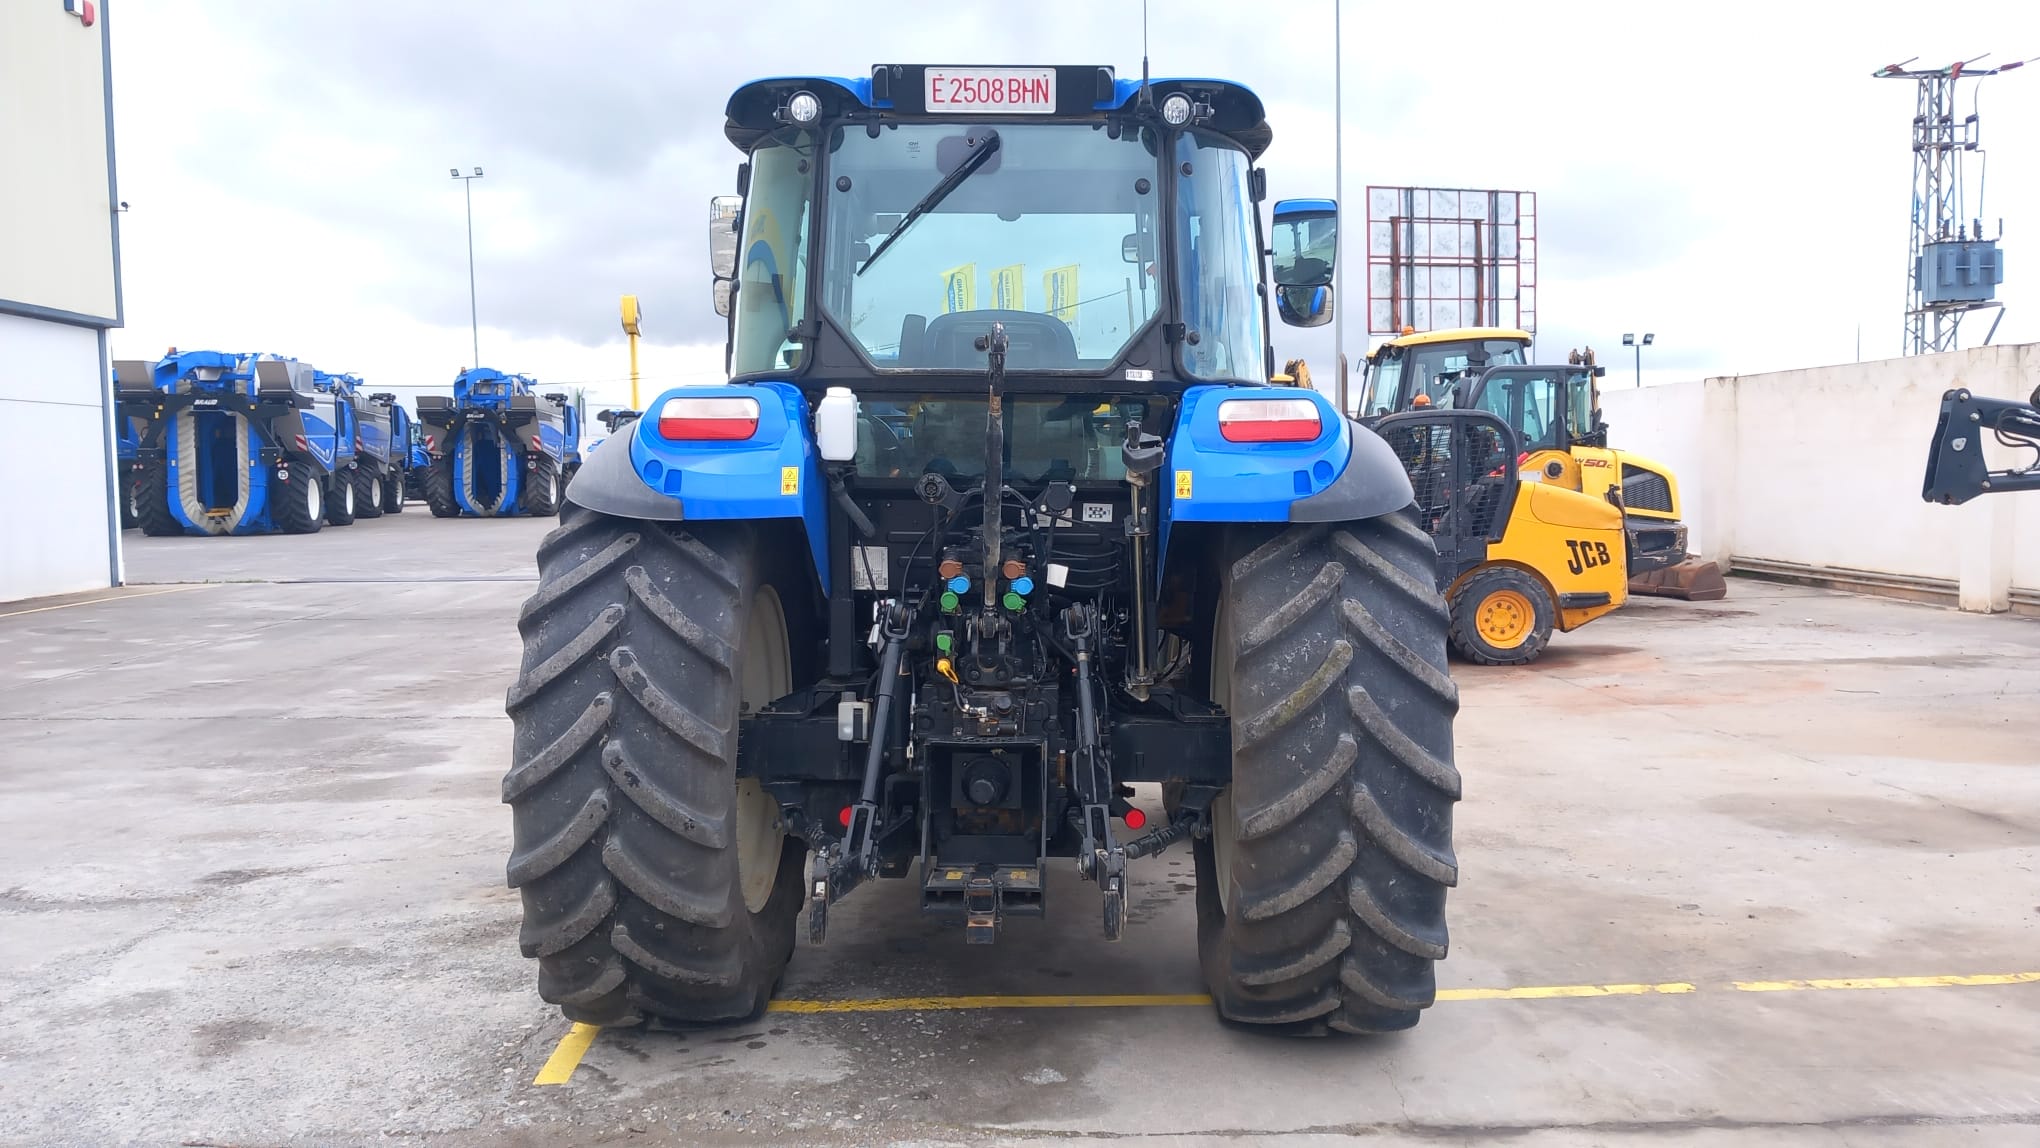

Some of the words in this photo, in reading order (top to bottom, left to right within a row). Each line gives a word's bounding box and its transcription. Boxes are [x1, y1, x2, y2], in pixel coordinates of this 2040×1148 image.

[932, 77, 945, 103] E
[950, 78, 1004, 104] 2508
[1008, 78, 1049, 104] BHN
[1565, 540, 1611, 576] JCB
